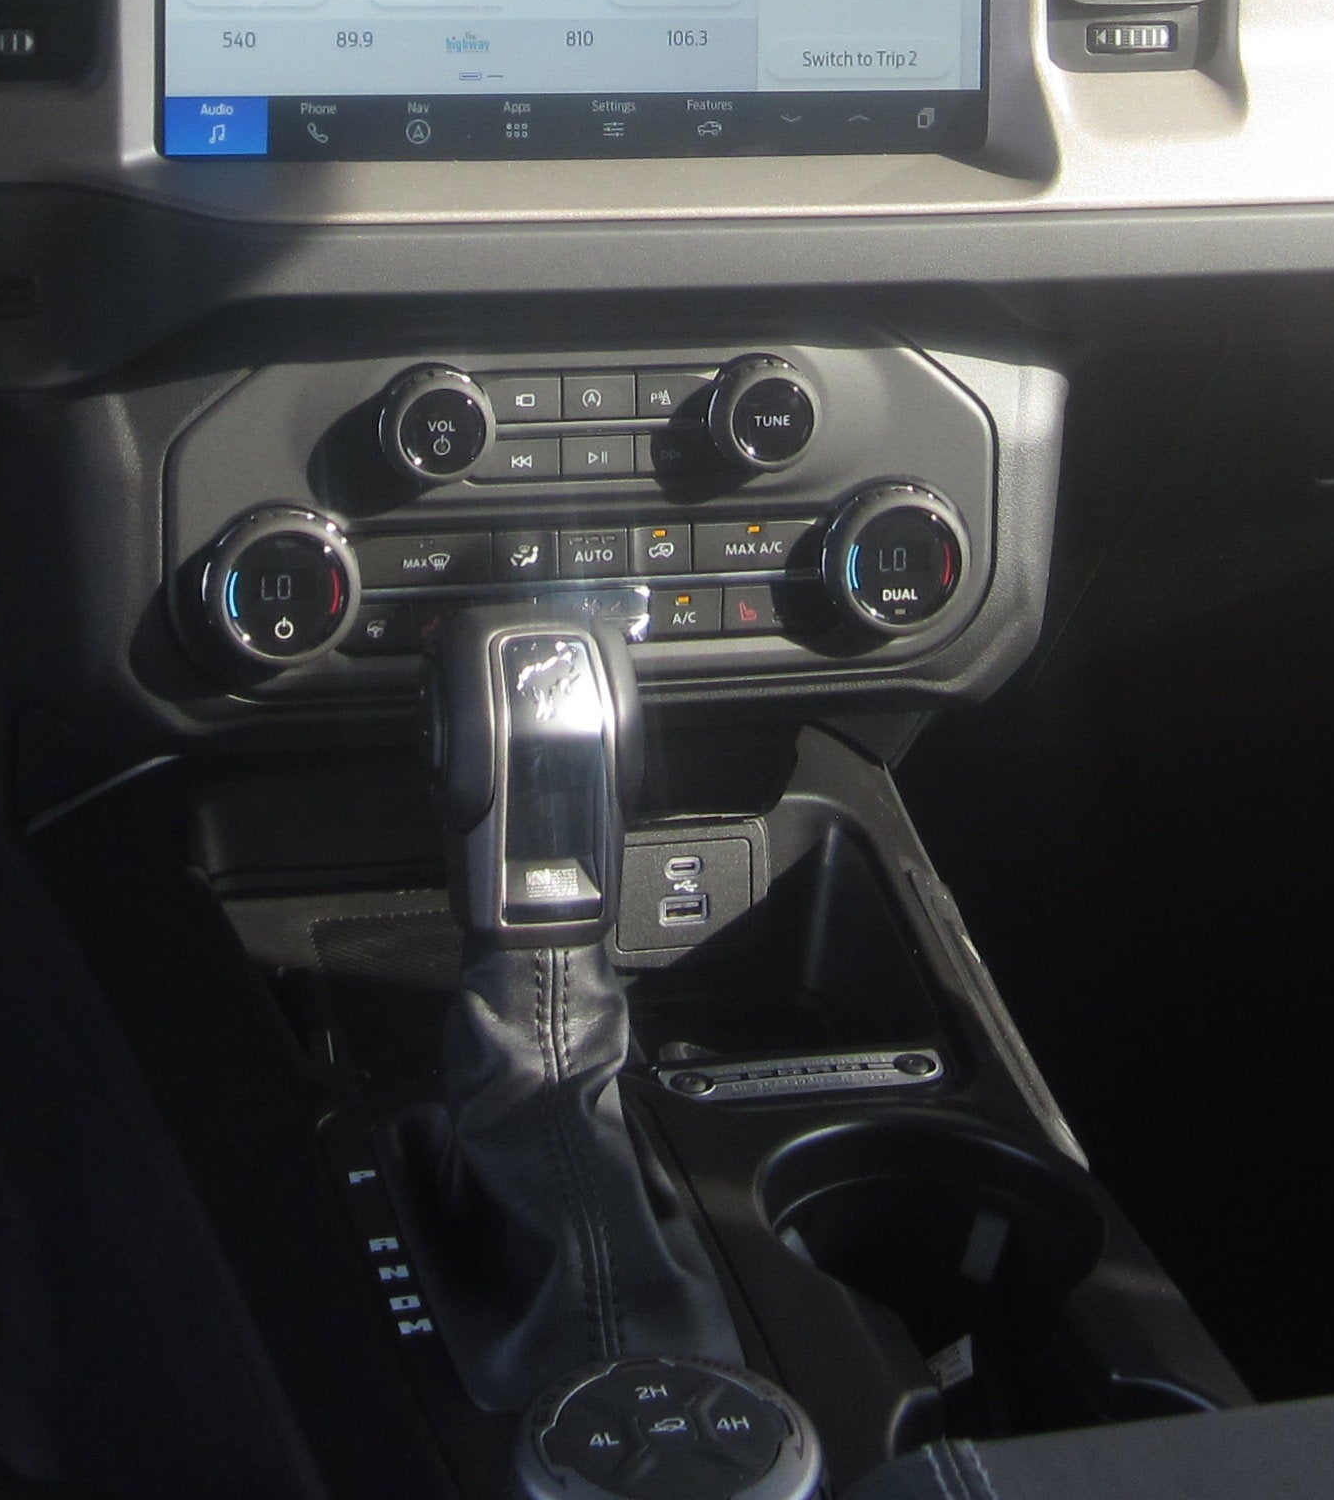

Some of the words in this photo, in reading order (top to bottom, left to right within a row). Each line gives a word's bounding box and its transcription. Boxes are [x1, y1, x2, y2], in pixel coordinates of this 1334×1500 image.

[222, 32, 256, 48] 540
[336, 32, 373, 48] 89.9
[566, 31, 593, 46] 810
[666, 30, 708, 46] 106.3
[802, 51, 853, 67] Switch
[857, 53, 873, 67] to
[876, 51, 906, 69] Trip
[909, 51, 917, 67] 2
[200, 103, 233, 116] Audio
[300, 102, 337, 115] Phone
[407, 102, 430, 114] Nav
[503, 101, 531, 114] Apps
[592, 99, 636, 113] Settings
[687, 100, 733, 111] Features
[427, 420, 456, 433] VOL
[754, 414, 791, 428] TUNE
[725, 544, 756, 556] MAX
[760, 541, 783, 554] A/C
[403, 558, 428, 569] MAX
[574, 550, 613, 563] AUTO
[878, 547, 906, 572] LO
[261, 575, 291, 599] LO
[882, 588, 918, 602] DUAL
[672, 611, 697, 625] A/C
[348, 1170, 376, 1184] P
[368, 1237, 399, 1252] R
[379, 1265, 409, 1281] N
[389, 1294, 421, 1310] D
[398, 1317, 434, 1335] M
[634, 1384, 669, 1401] 2H
[716, 1415, 750, 1431] 4H
[589, 1431, 621, 1448] 4L
